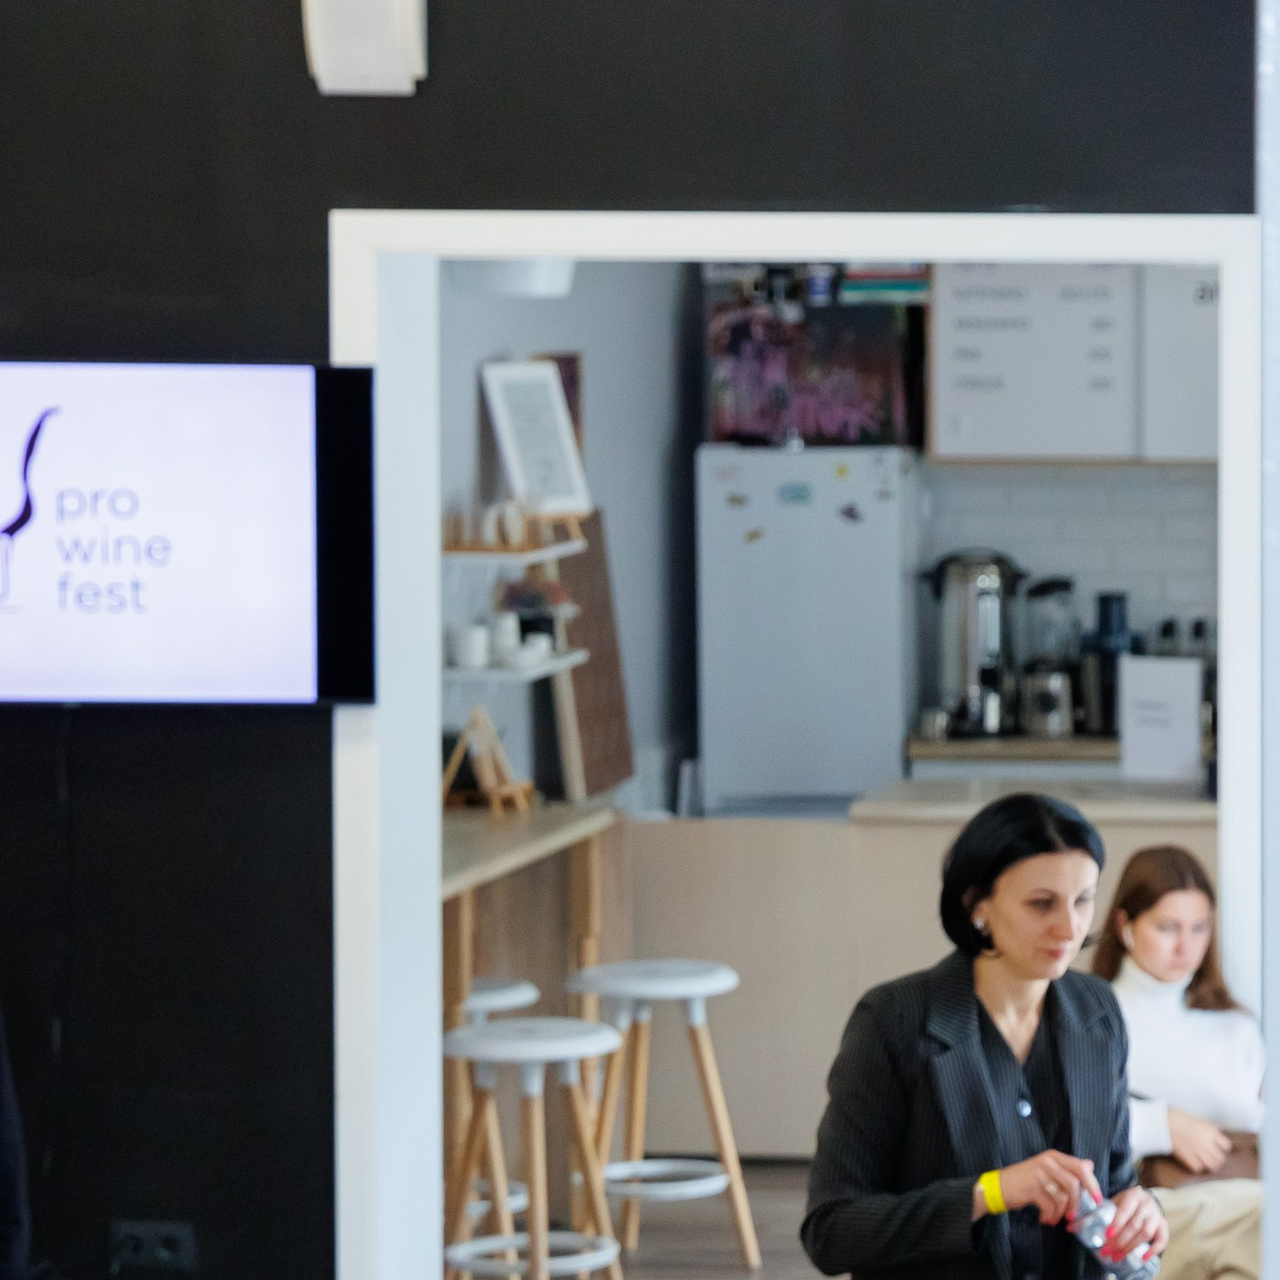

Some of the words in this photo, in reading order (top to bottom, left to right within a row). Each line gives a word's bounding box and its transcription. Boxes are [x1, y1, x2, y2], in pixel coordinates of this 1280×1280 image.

[56, 487, 140, 524] pro
[56, 527, 172, 568] wine
[57, 571, 147, 614] fest
